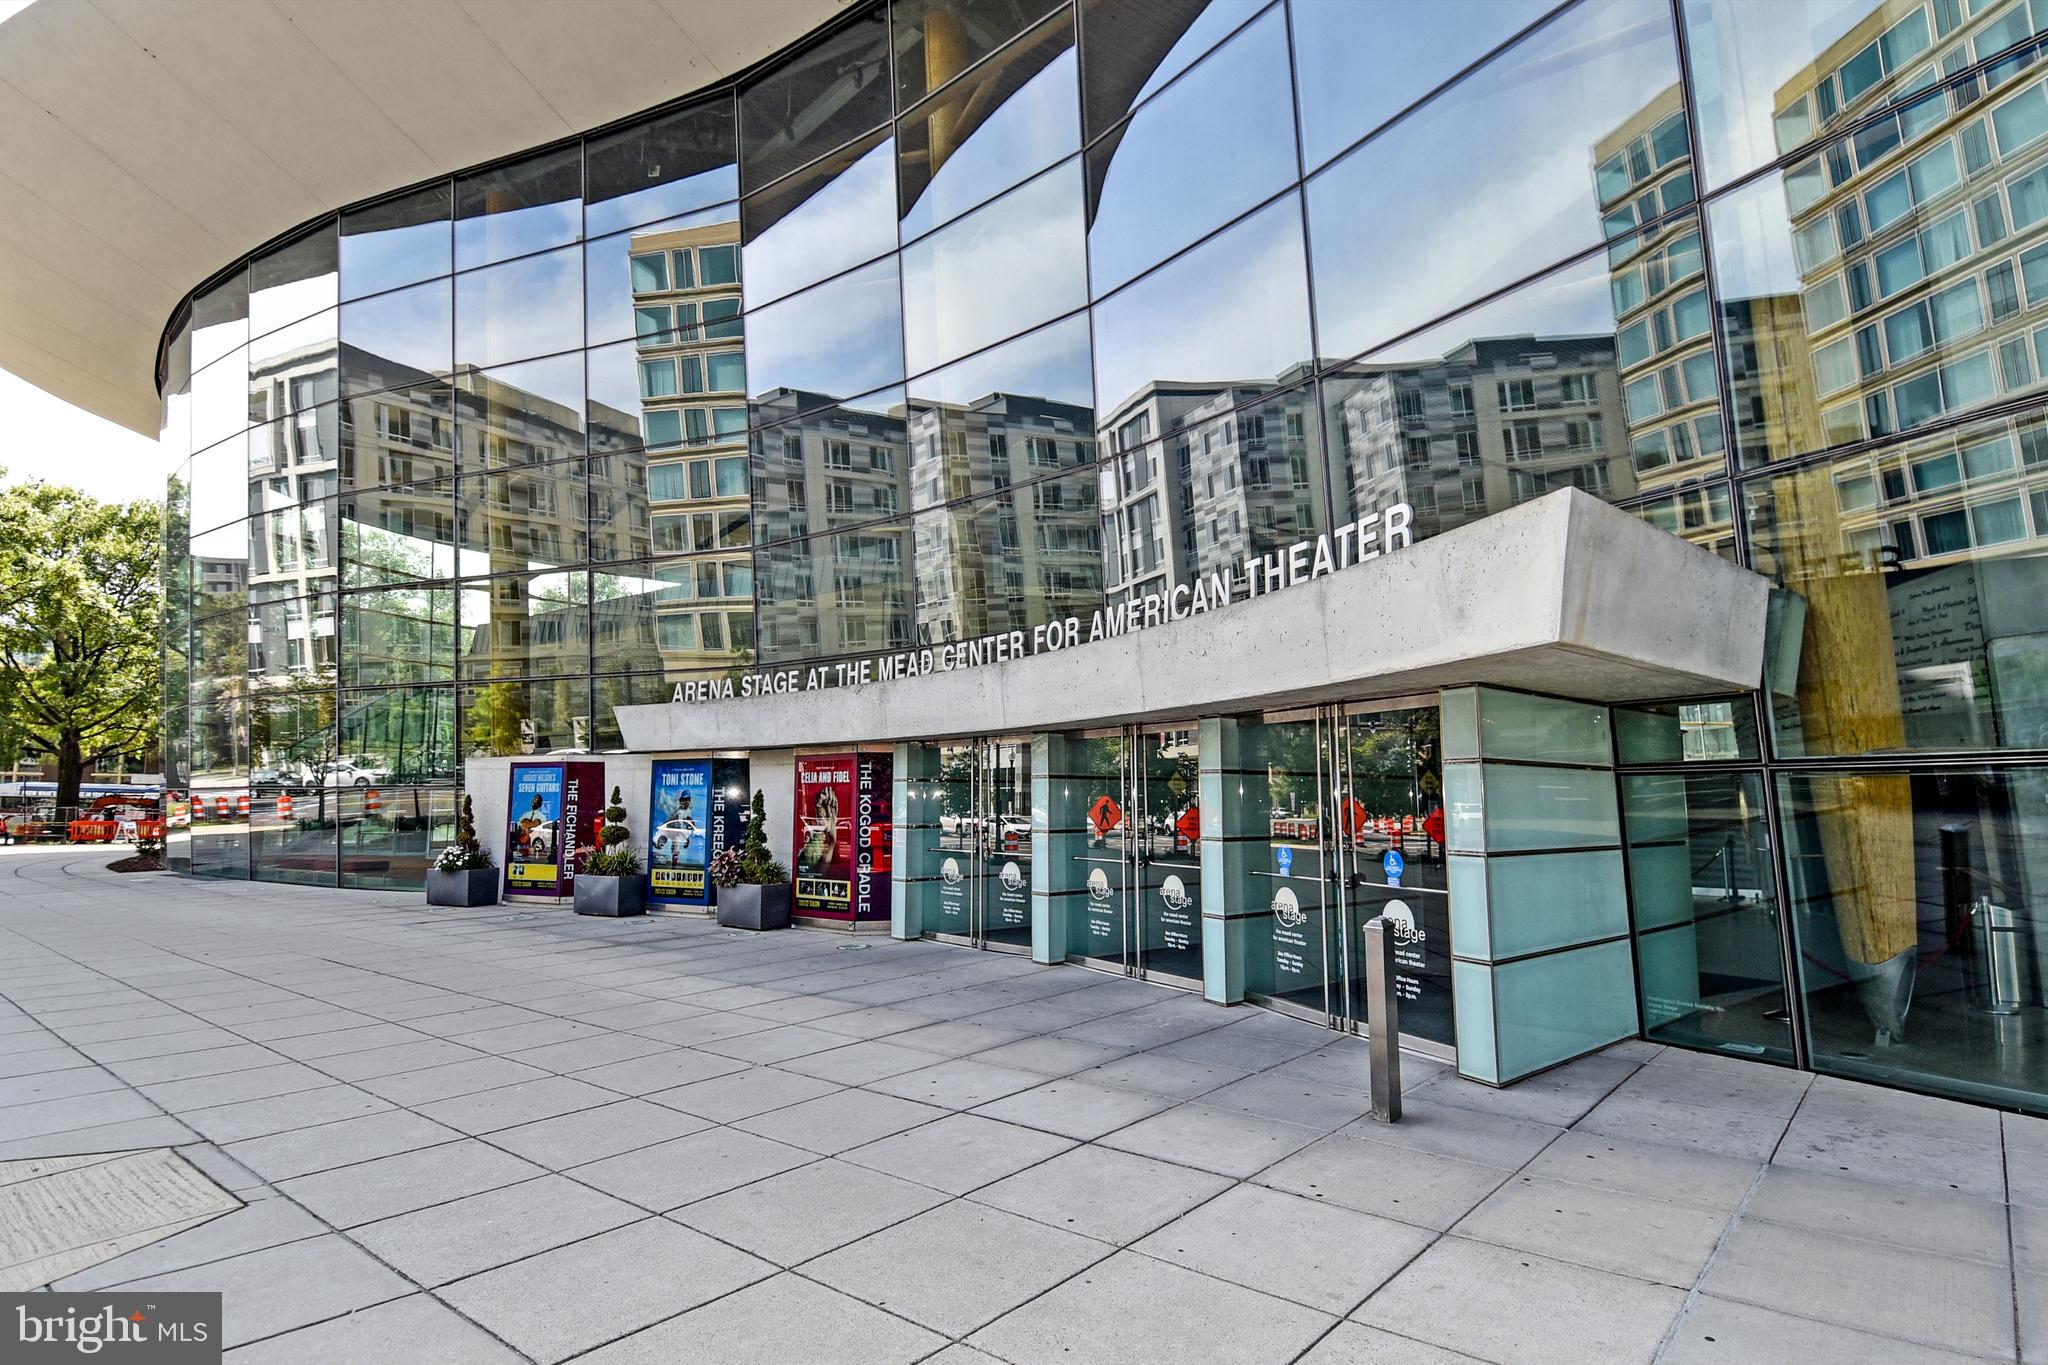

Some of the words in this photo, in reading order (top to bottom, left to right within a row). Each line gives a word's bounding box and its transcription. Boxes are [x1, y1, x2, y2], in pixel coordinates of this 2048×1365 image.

[672, 677, 734, 702] ARENA
[741, 670, 798, 697] STAGE
[806, 666, 829, 691] AT
[835, 659, 871, 687] THE
[878, 649, 933, 682] MEAD
[942, 631, 1024, 670] CENTER
[1033, 616, 1079, 656] FOR
[1089, 568, 1231, 640] AMERICAN
[1244, 503, 1413, 599] THEATER
[662, 773, 679, 786] TONI
[680, 773, 704, 786] STONE
[801, 771, 817, 783] CELIA
[818, 771, 831, 783] AND
[833, 771, 850, 783] FIDEL
[859, 762, 872, 790] THE
[518, 783, 535, 793] SEVEN
[536, 782, 560, 793] GUITARS
[567, 779, 579, 802] THE
[713, 787, 725, 812] THE
[859, 795, 872, 848] KOGOD
[563, 804, 578, 880] FICHANDLER
[858, 852, 871, 913] CRADLE
[1008, 879, 1026, 888] stage
[1160, 887, 1181, 898] arena
[1170, 895, 1193, 907] stage
[1271, 901, 1294, 912] arena
[1283, 910, 1307, 924] stage
[1394, 927, 1426, 943] stage
[1409, 959, 1426, 968] theater
